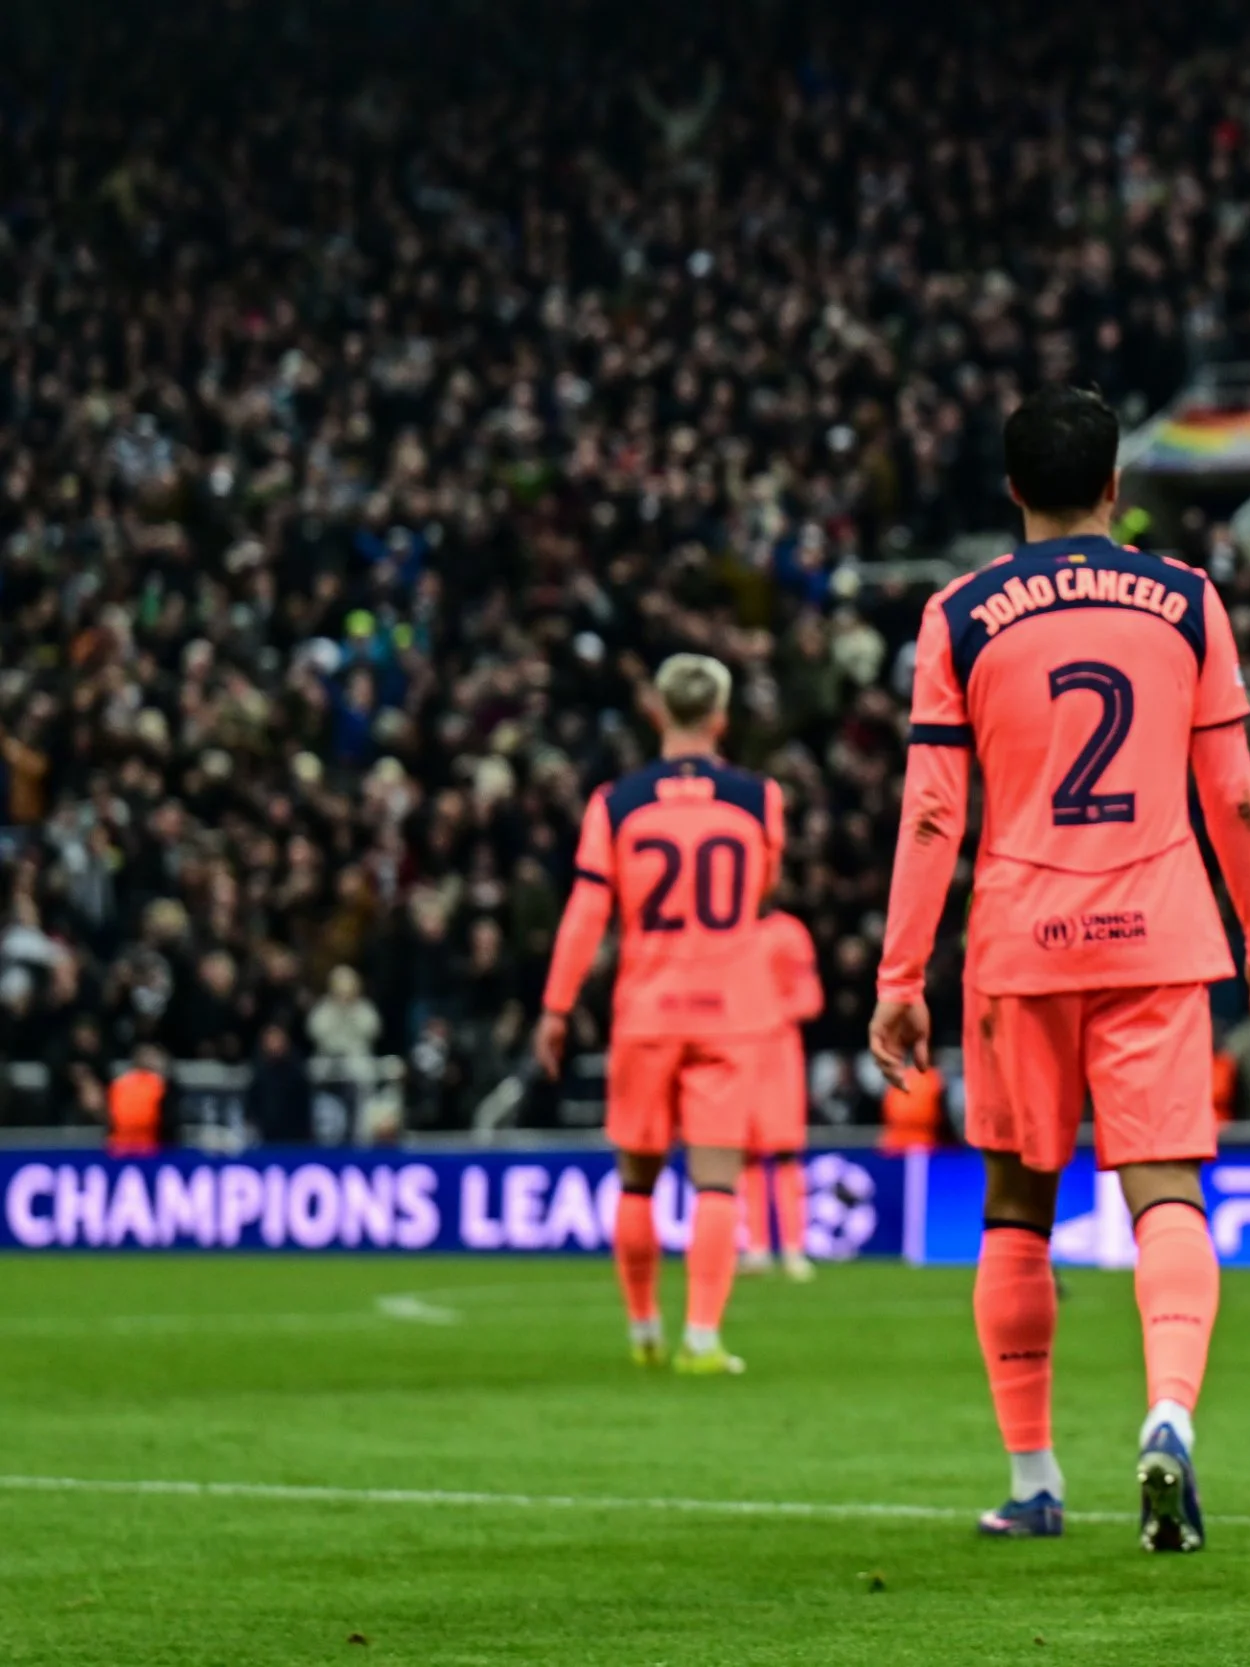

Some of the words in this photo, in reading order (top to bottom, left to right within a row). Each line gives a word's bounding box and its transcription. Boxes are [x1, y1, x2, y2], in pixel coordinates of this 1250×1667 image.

[970, 575, 1056, 637] JOÃO
[1055, 567, 1188, 624] CANCELO
[1048, 660, 1137, 826] 2
[633, 836, 747, 932] 20
[5, 1163, 440, 1248] CHAMPIONS
[459, 1164, 747, 1250] LEAU
